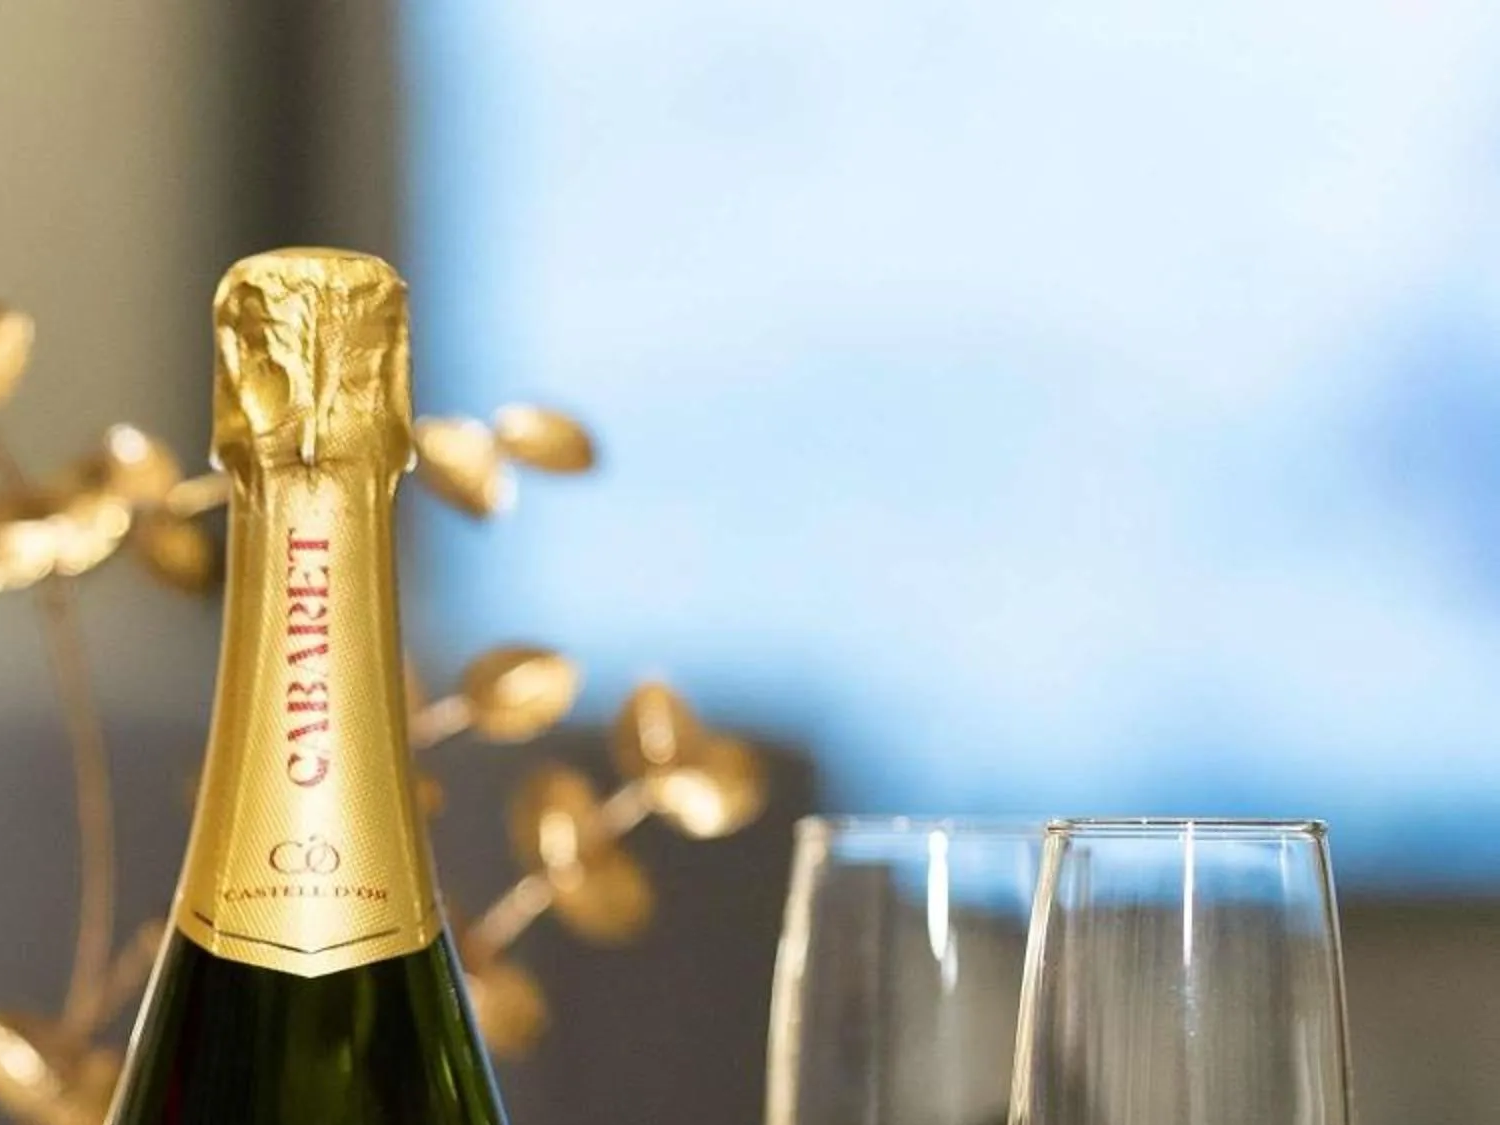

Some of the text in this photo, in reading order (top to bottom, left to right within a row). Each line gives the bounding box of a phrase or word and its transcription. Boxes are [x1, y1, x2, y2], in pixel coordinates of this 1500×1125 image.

[287, 528, 330, 787] CABARET
[224, 886, 389, 902] CASTELL D'OR
